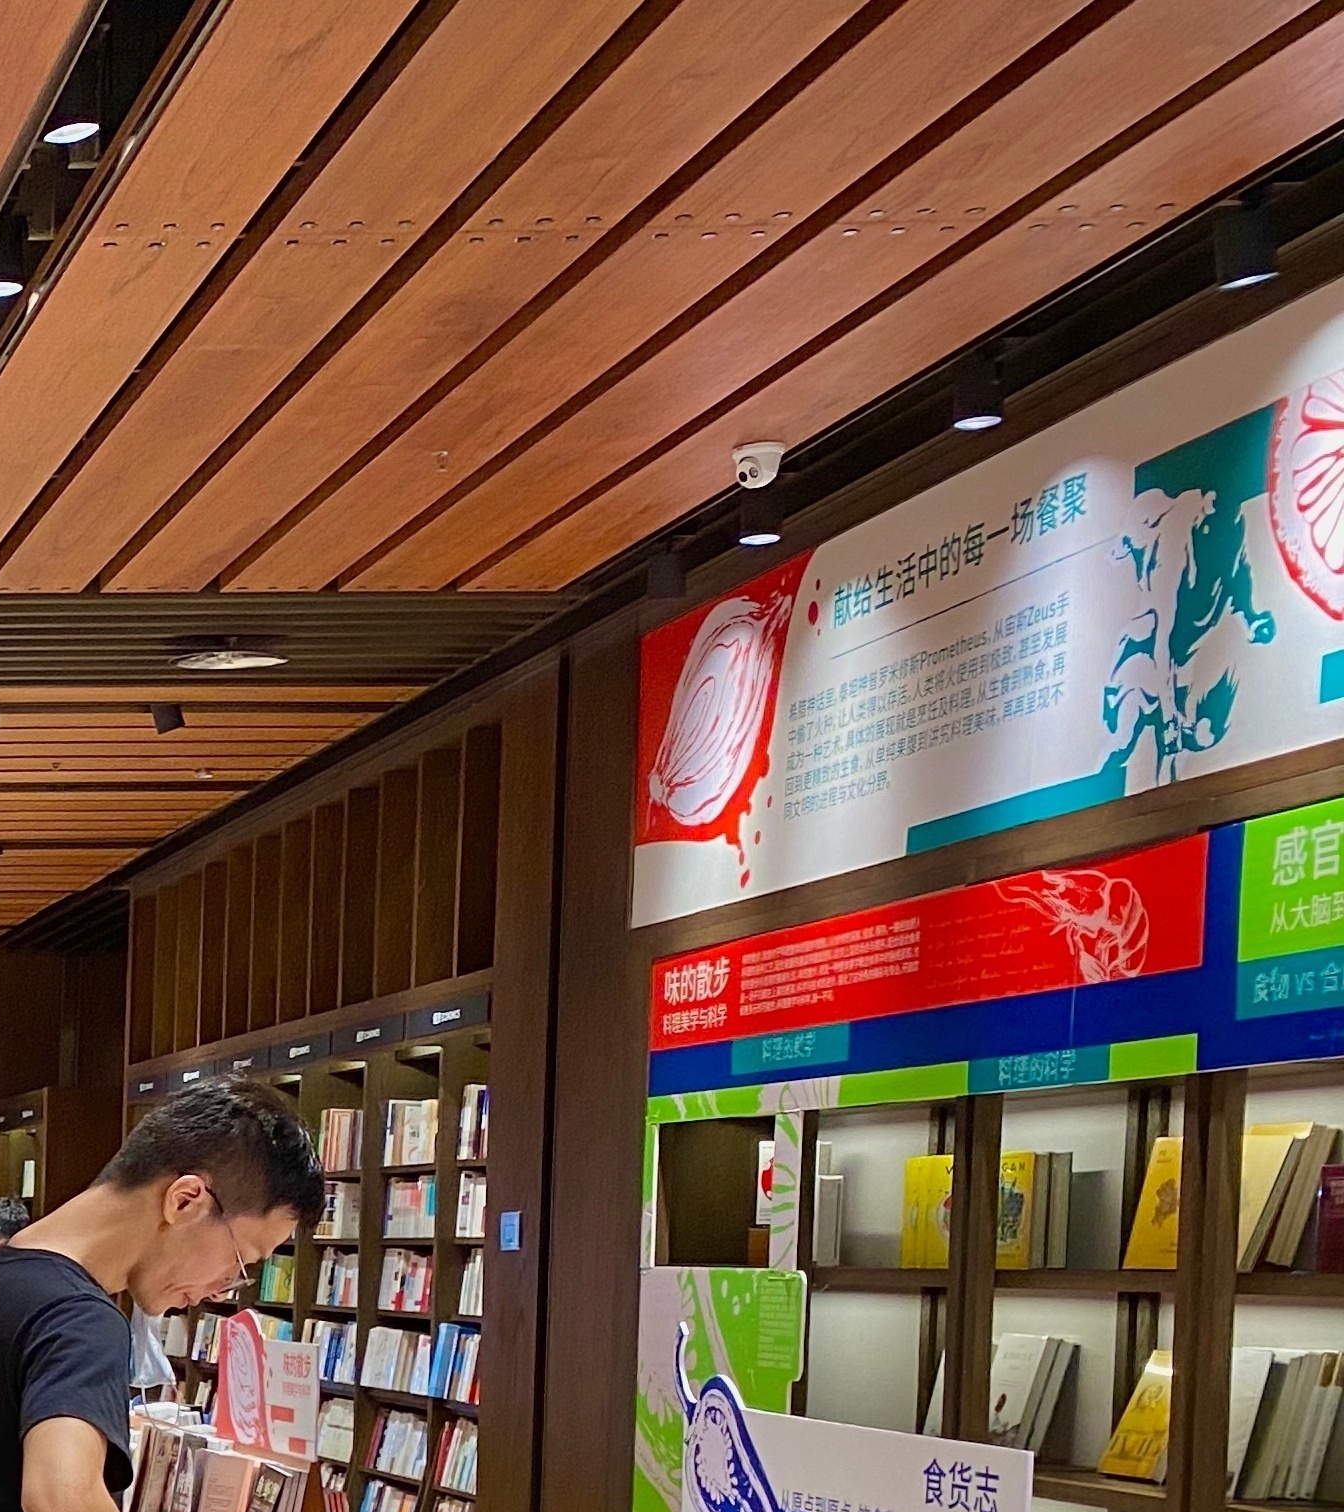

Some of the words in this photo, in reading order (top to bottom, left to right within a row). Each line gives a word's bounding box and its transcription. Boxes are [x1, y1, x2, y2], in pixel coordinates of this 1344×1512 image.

[833, 472, 1087, 629] 献给生活中的每一场餐聚
[1272, 819, 1344, 886] 感官
[664, 955, 731, 1007] 味的散步
